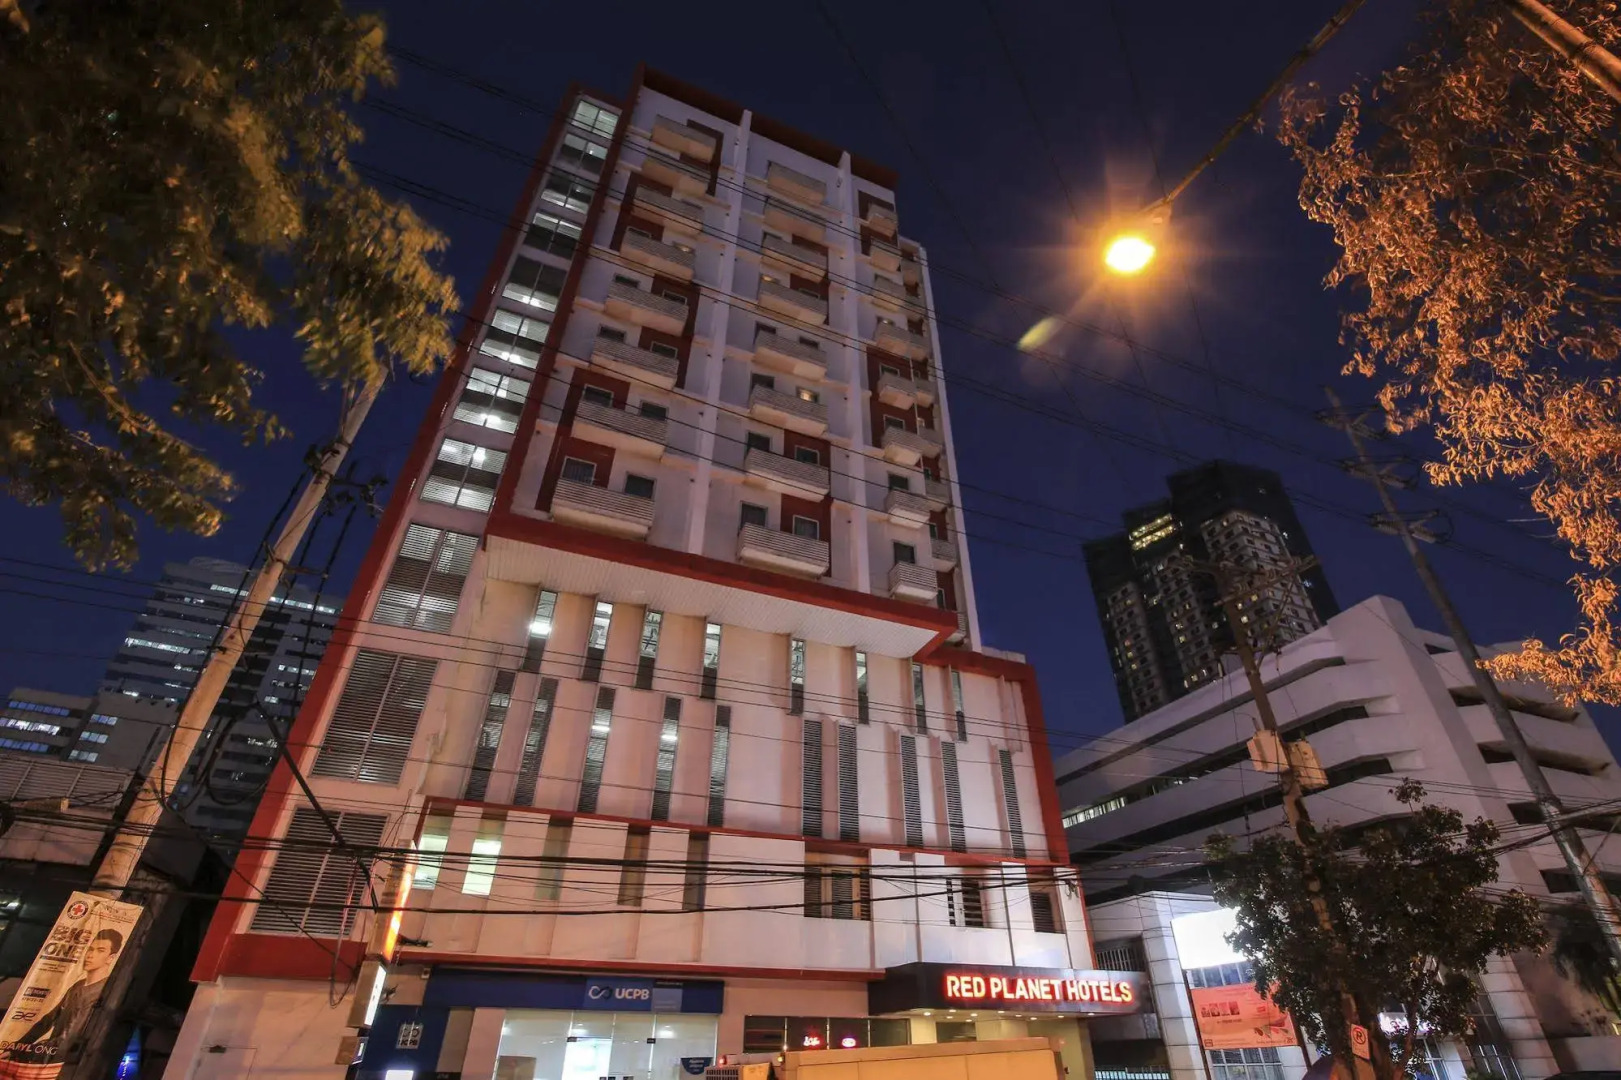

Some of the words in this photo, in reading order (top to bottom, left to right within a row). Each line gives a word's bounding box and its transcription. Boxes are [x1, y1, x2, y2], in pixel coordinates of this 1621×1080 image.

[614, 987, 650, 1000] UCPB
[946, 975, 986, 998] RED
[990, 977, 1063, 1001] PLANET
[1066, 979, 1133, 1003] HOTELS
